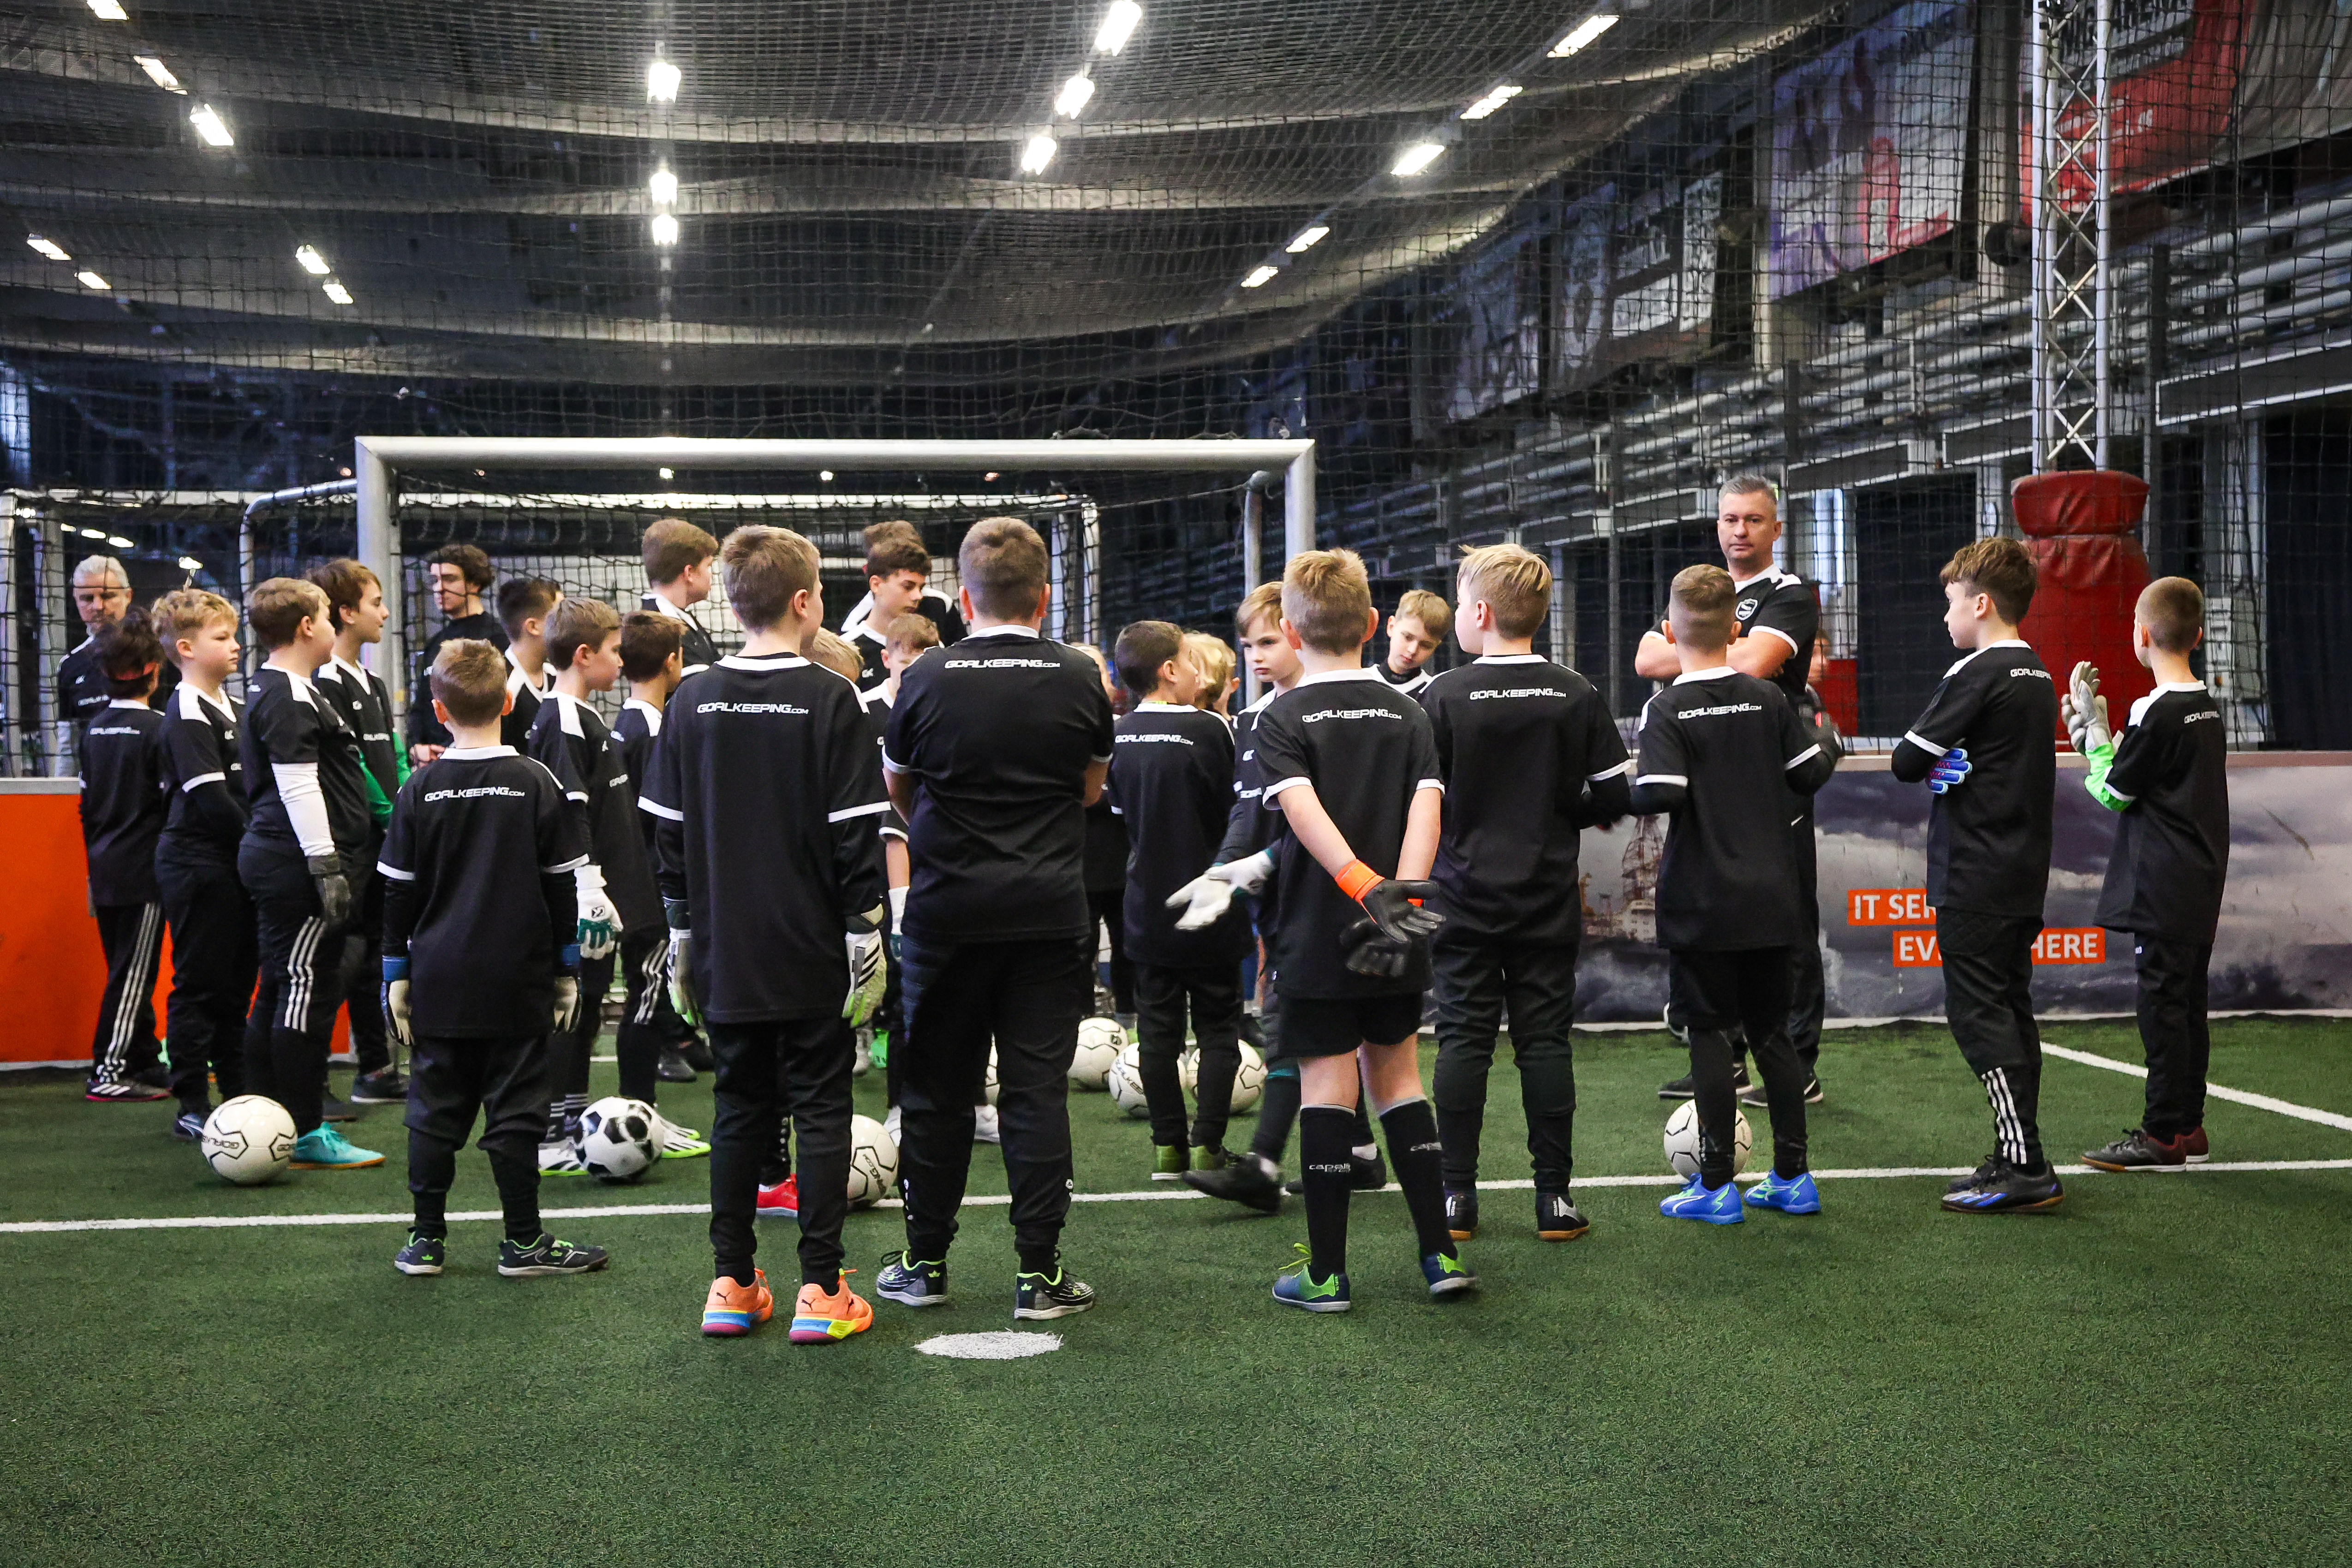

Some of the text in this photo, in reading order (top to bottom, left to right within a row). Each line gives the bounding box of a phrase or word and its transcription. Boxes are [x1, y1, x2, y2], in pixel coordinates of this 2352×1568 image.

[1470, 688, 1566, 700] GOALKEEPING.COM
[697, 702, 809, 714] GOALKEEPING.COM
[1678, 703, 1762, 719] GOALKEEPING.COM
[424, 786, 525, 802] GOALKEEPING.COM
[1855, 894, 1880, 919] IT
